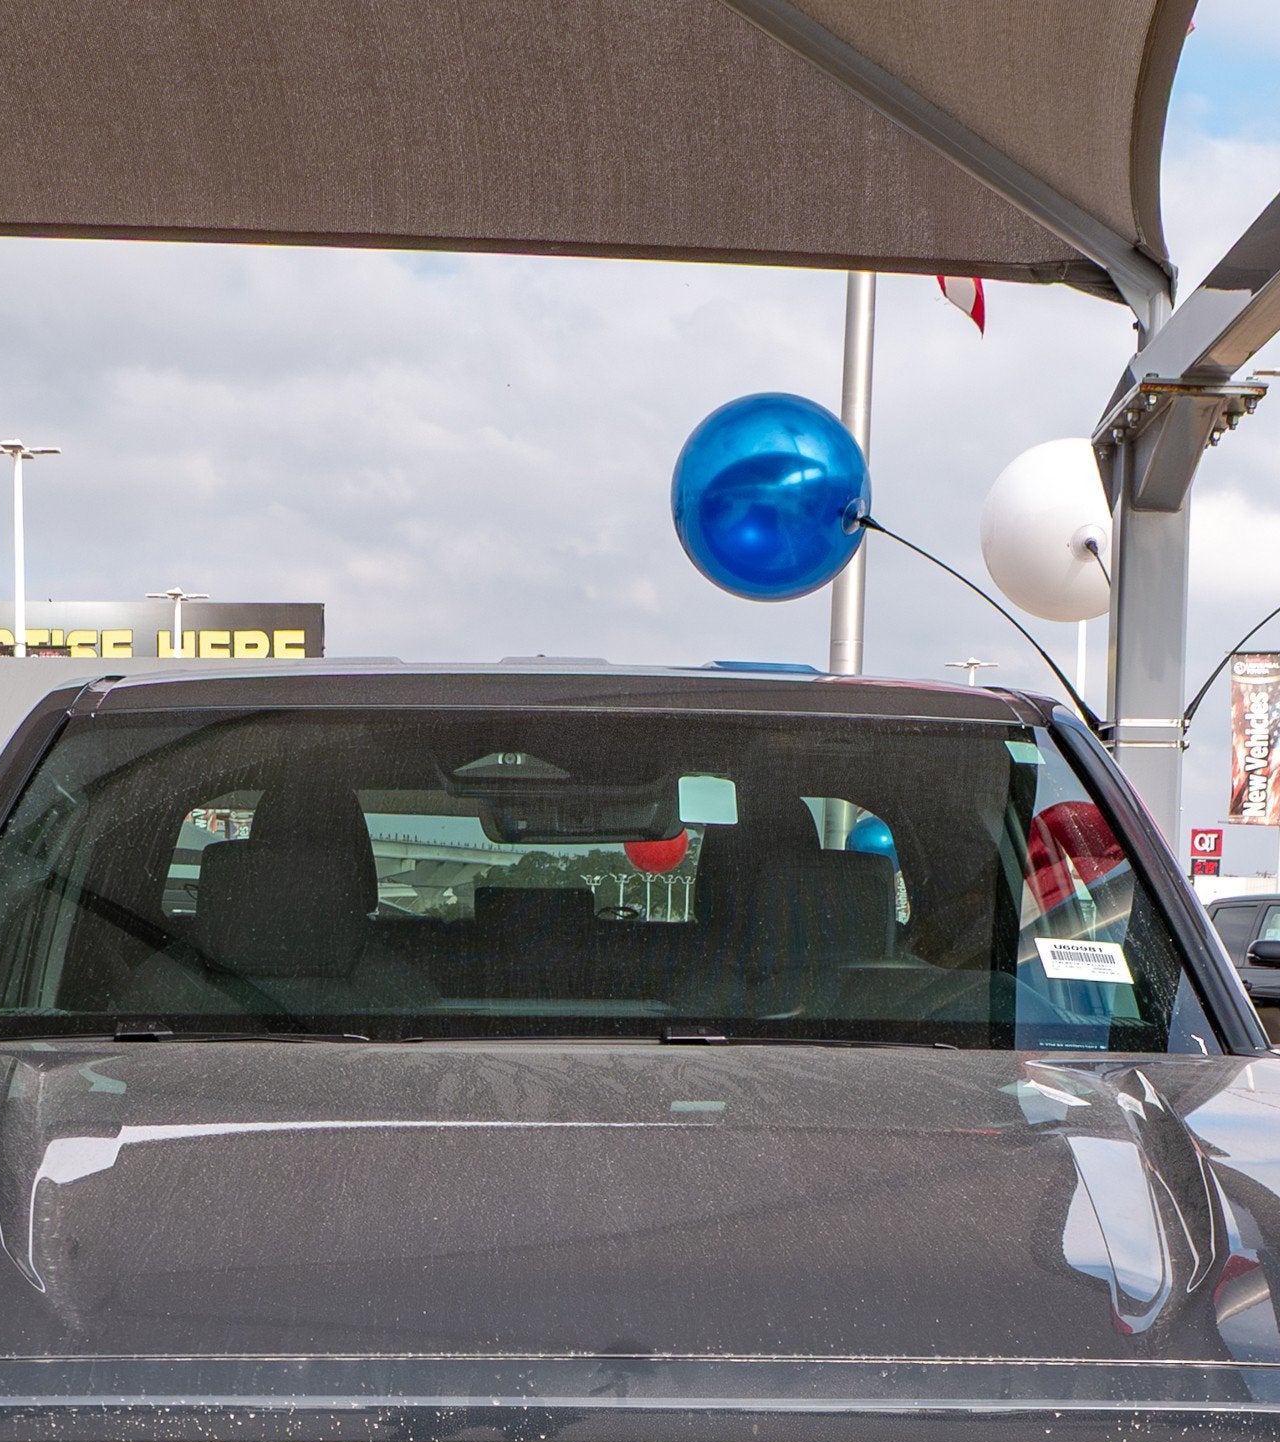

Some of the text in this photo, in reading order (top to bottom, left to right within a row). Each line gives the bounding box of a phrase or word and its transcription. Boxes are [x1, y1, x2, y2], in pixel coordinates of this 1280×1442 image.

[1244, 691, 1269, 772] Vehicles
[1242, 774, 1268, 817] New
[1194, 833, 1218, 852] QT
